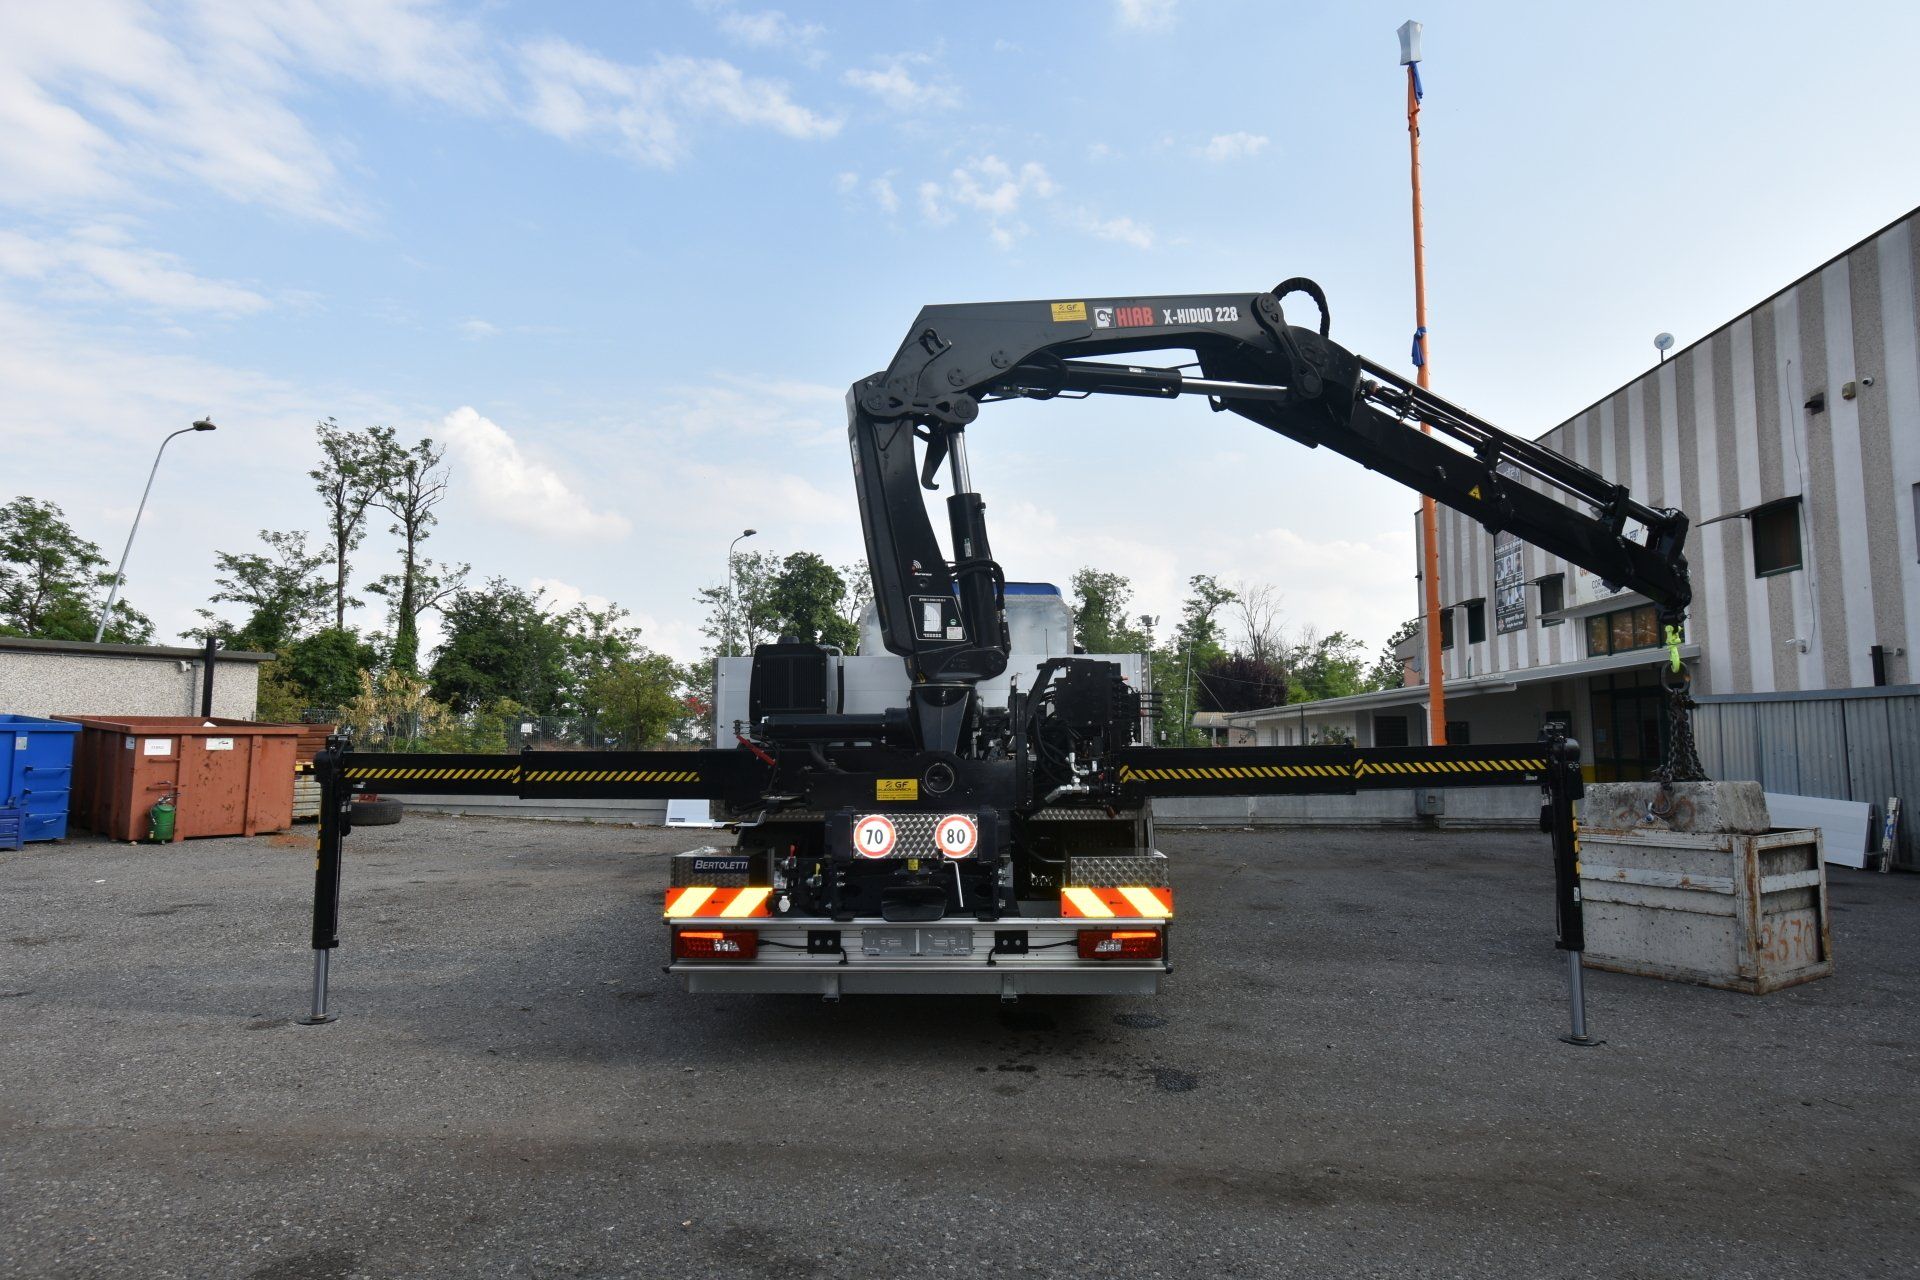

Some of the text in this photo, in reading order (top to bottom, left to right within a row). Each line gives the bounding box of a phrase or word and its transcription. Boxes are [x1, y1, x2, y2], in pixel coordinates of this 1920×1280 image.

[1116, 306, 1239, 327] HIAB X-HIDUO 228
[865, 829, 883, 845] 70
[946, 829, 965, 844] 80
[694, 860, 748, 869] BERTOLETTI
